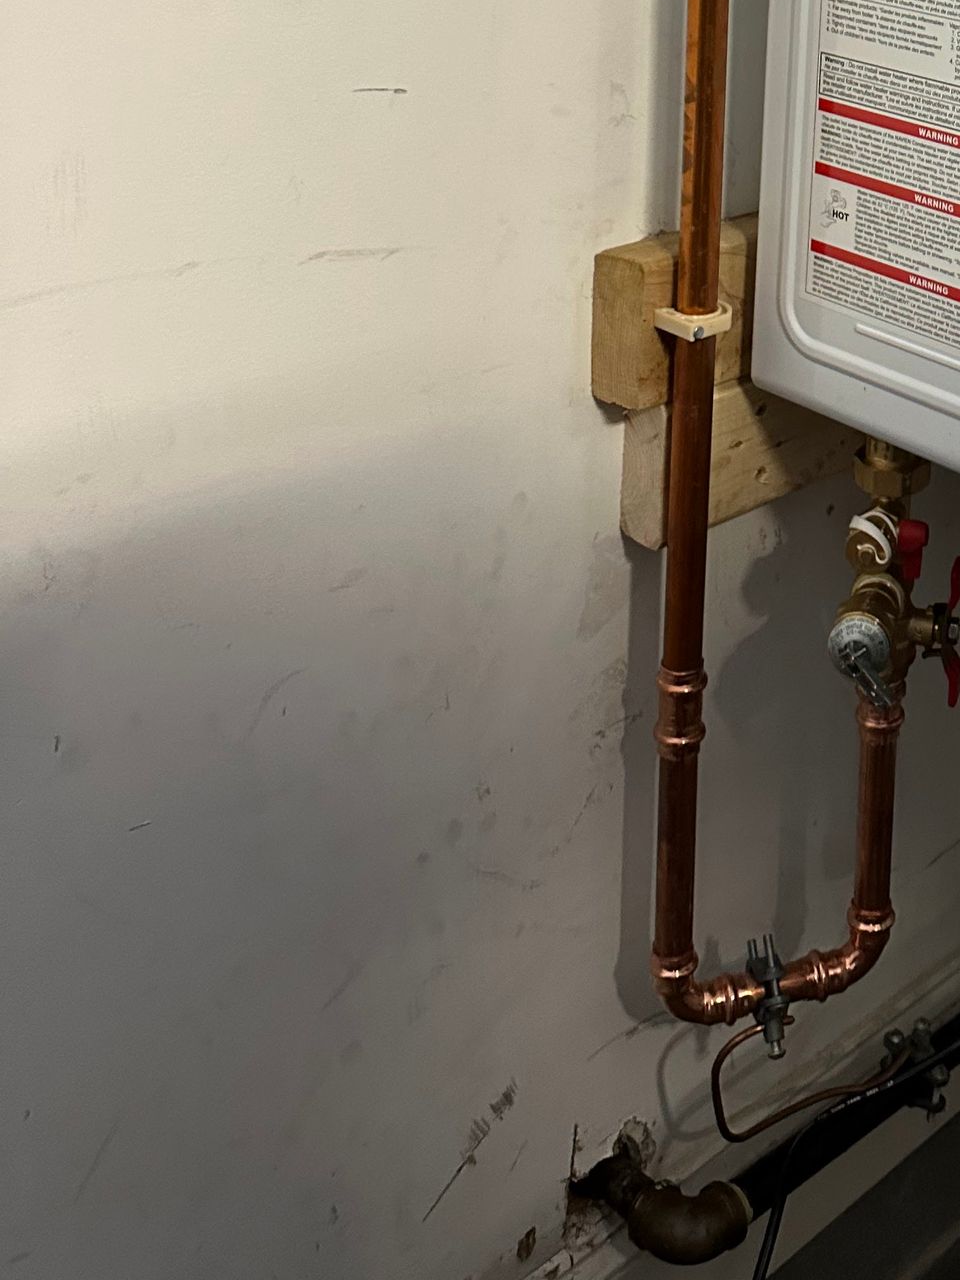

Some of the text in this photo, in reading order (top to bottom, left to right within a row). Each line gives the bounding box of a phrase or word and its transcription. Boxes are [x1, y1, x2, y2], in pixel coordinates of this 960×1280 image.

[917, 127, 959, 146] WARNING
[913, 192, 954, 213] WARNING
[831, 208, 849, 222] HOT
[908, 274, 948, 296] WARNING
